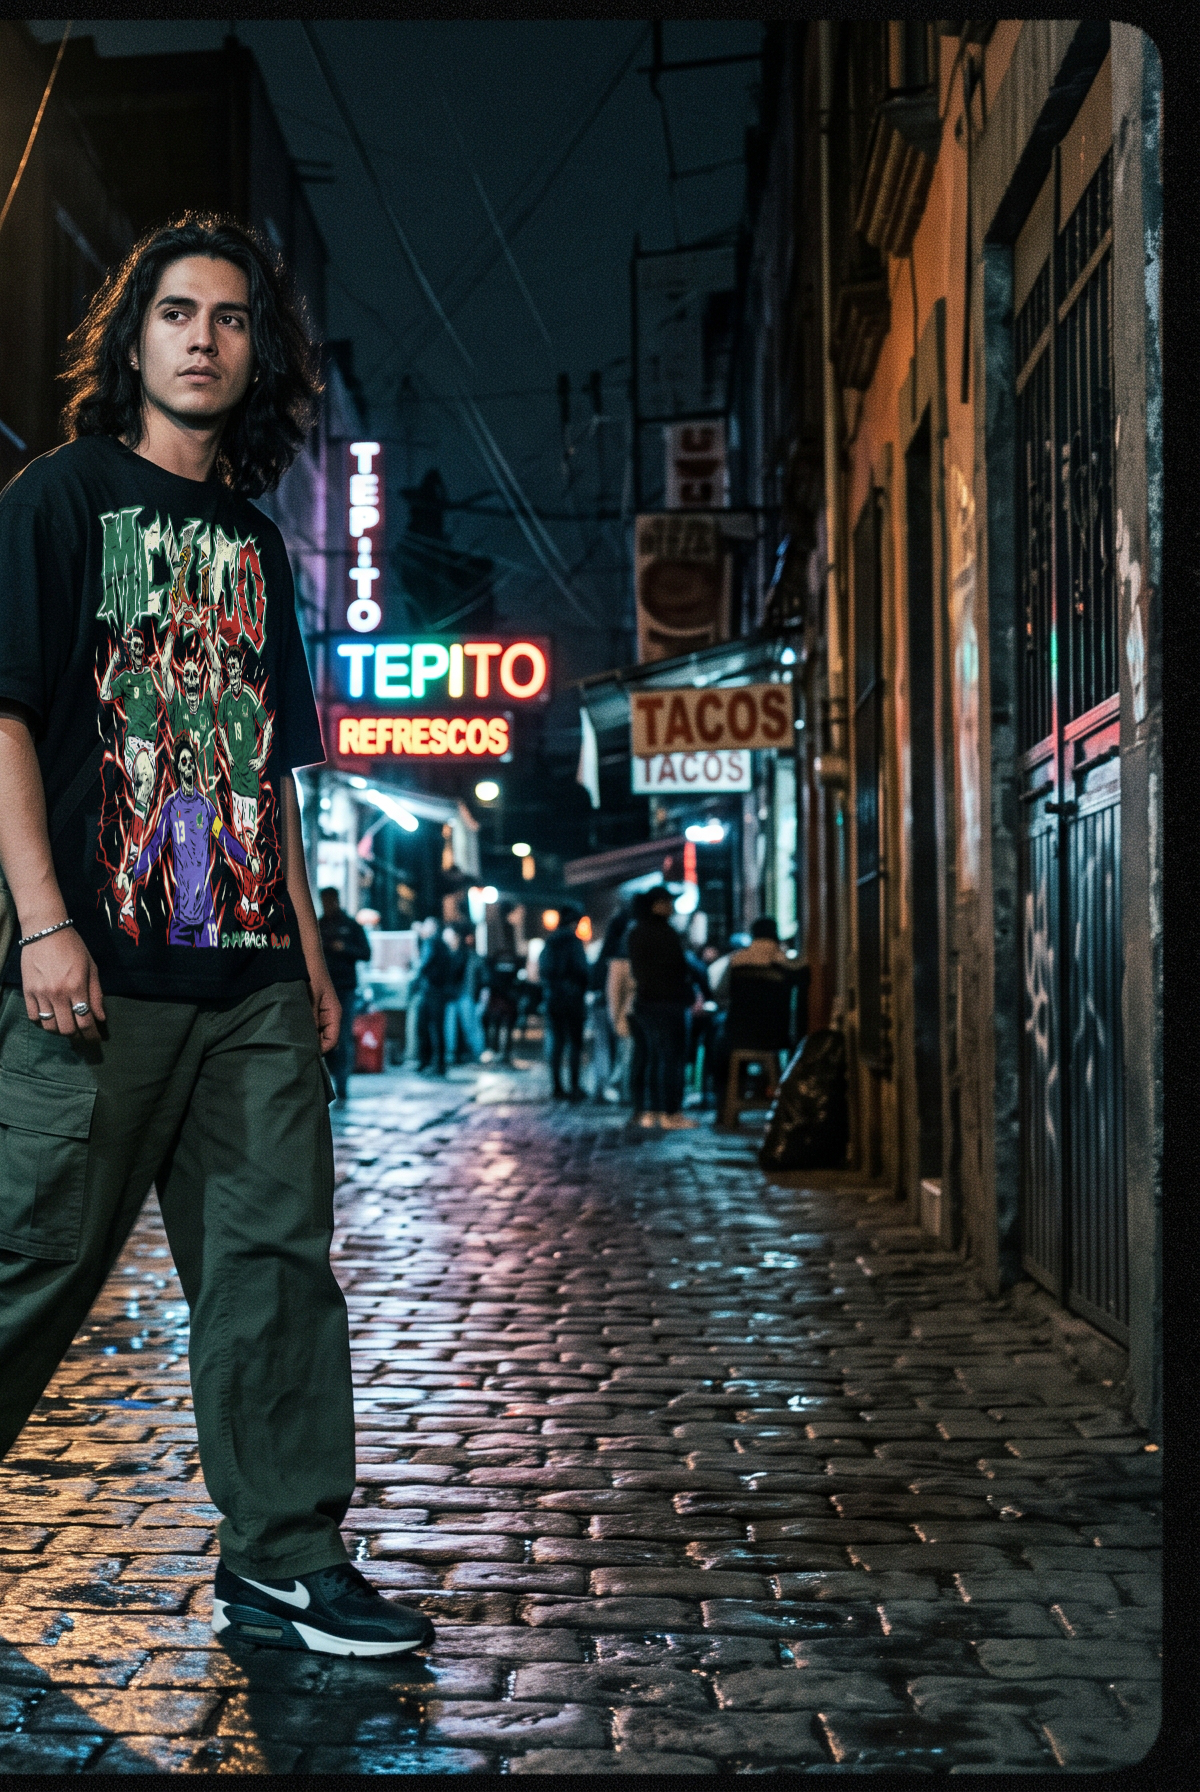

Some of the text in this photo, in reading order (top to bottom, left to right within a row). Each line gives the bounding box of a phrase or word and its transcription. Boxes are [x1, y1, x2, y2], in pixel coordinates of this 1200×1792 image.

[96, 505, 268, 658] MEXICO
[337, 642, 547, 699] TEPITO
[133, 686, 140, 699] 9
[636, 689, 788, 747] TACOS
[339, 717, 509, 755] REFRESCOS
[638, 752, 744, 784] TACOS
[174, 819, 186, 844] 13
[207, 923, 218, 947] 13
[221, 931, 268, 950] SNAPBACK
